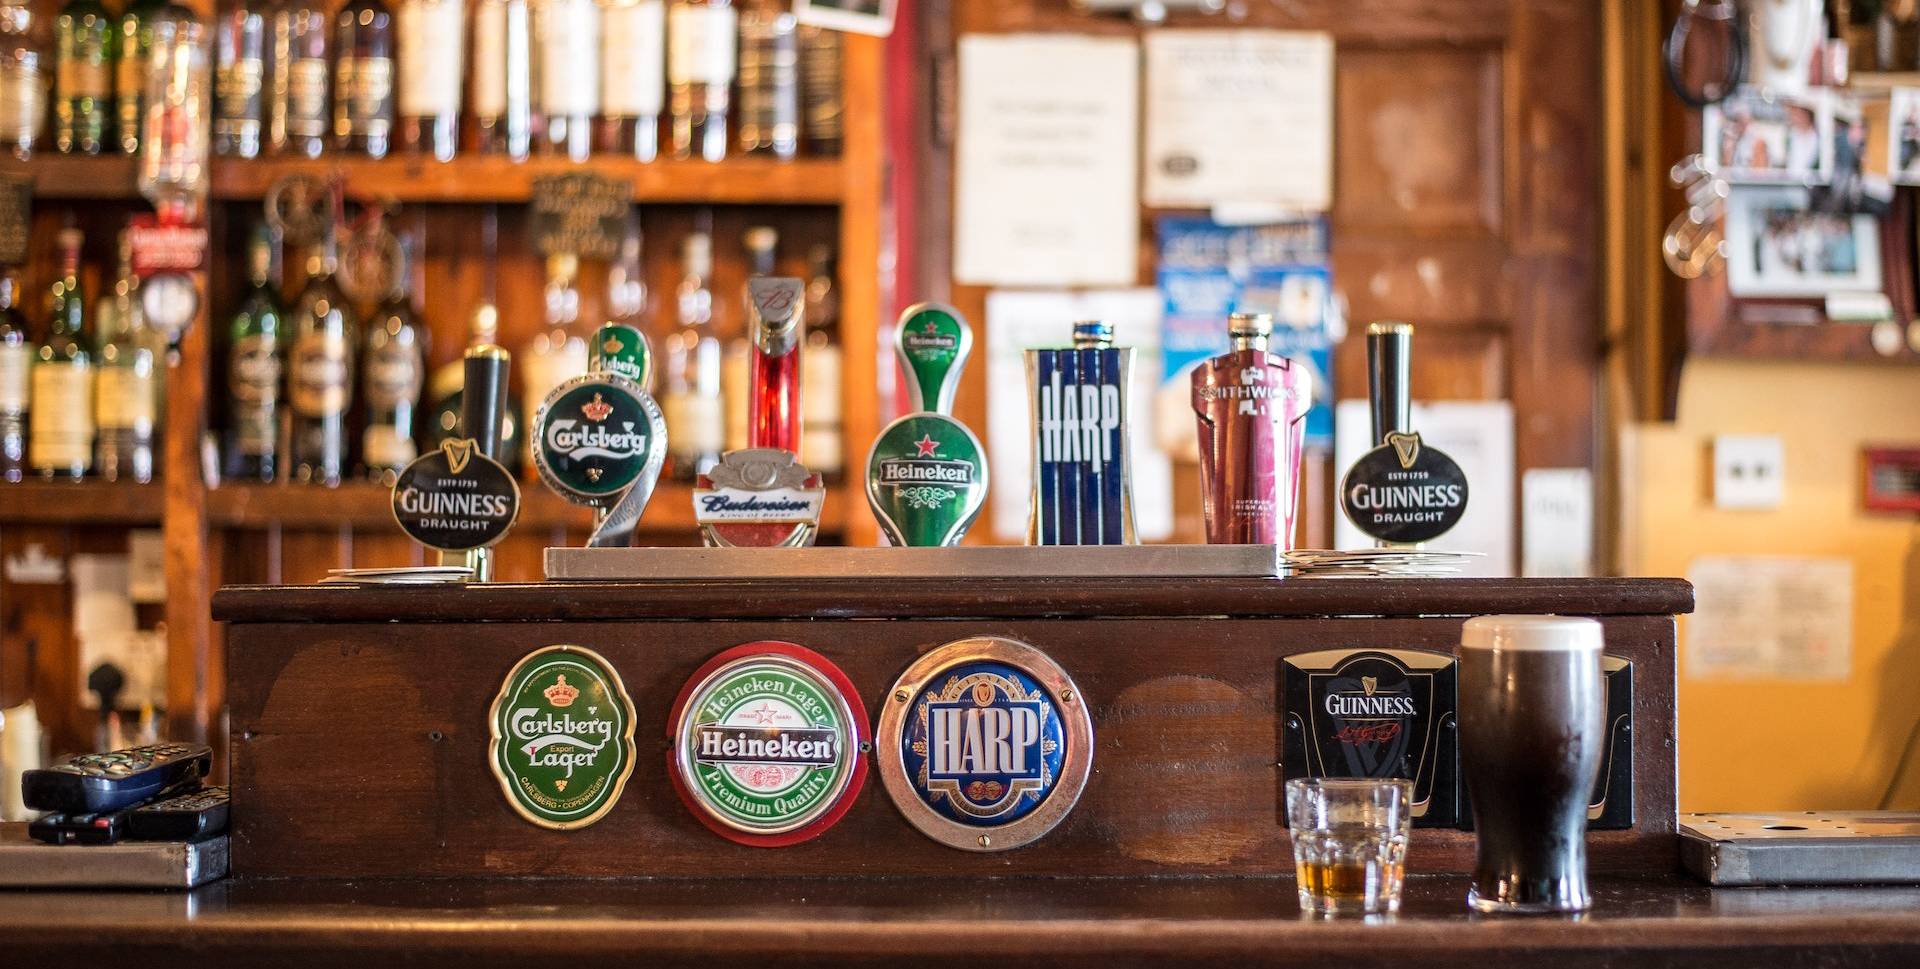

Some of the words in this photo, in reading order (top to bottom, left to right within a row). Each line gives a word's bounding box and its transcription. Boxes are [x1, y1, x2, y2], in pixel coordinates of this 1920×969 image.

[910, 336, 953, 346] Heineken
[590, 353, 640, 380] Clsberg
[1200, 385, 1301, 400] SMITHWI
[1042, 370, 1119, 473] HARP
[547, 419, 646, 458] Carlsberg
[886, 464, 967, 481] Heineken
[1409, 472, 1429, 480] 1759
[402, 487, 507, 517] GUINNESS
[702, 495, 810, 512] Budweiser
[1351, 484, 1460, 510] GUINNESS
[420, 518, 489, 531] DRAUGHT
[1374, 511, 1444, 523] DRAUGHT
[706, 677, 784, 718] Heineken
[786, 681, 828, 723] Lager
[1325, 694, 1414, 715] GUINNESS
[511, 706, 613, 743] Carlsberg
[550, 745, 575, 753] Export
[702, 732, 832, 759] Heineken
[932, 707, 1039, 774] HARP
[529, 746, 598, 779] Lager
[521, 776, 557, 809] CARLSBERG
[562, 775, 605, 809] COPENHAGEN
[705, 769, 771, 815] Premium
[774, 772, 827, 815] Quality
